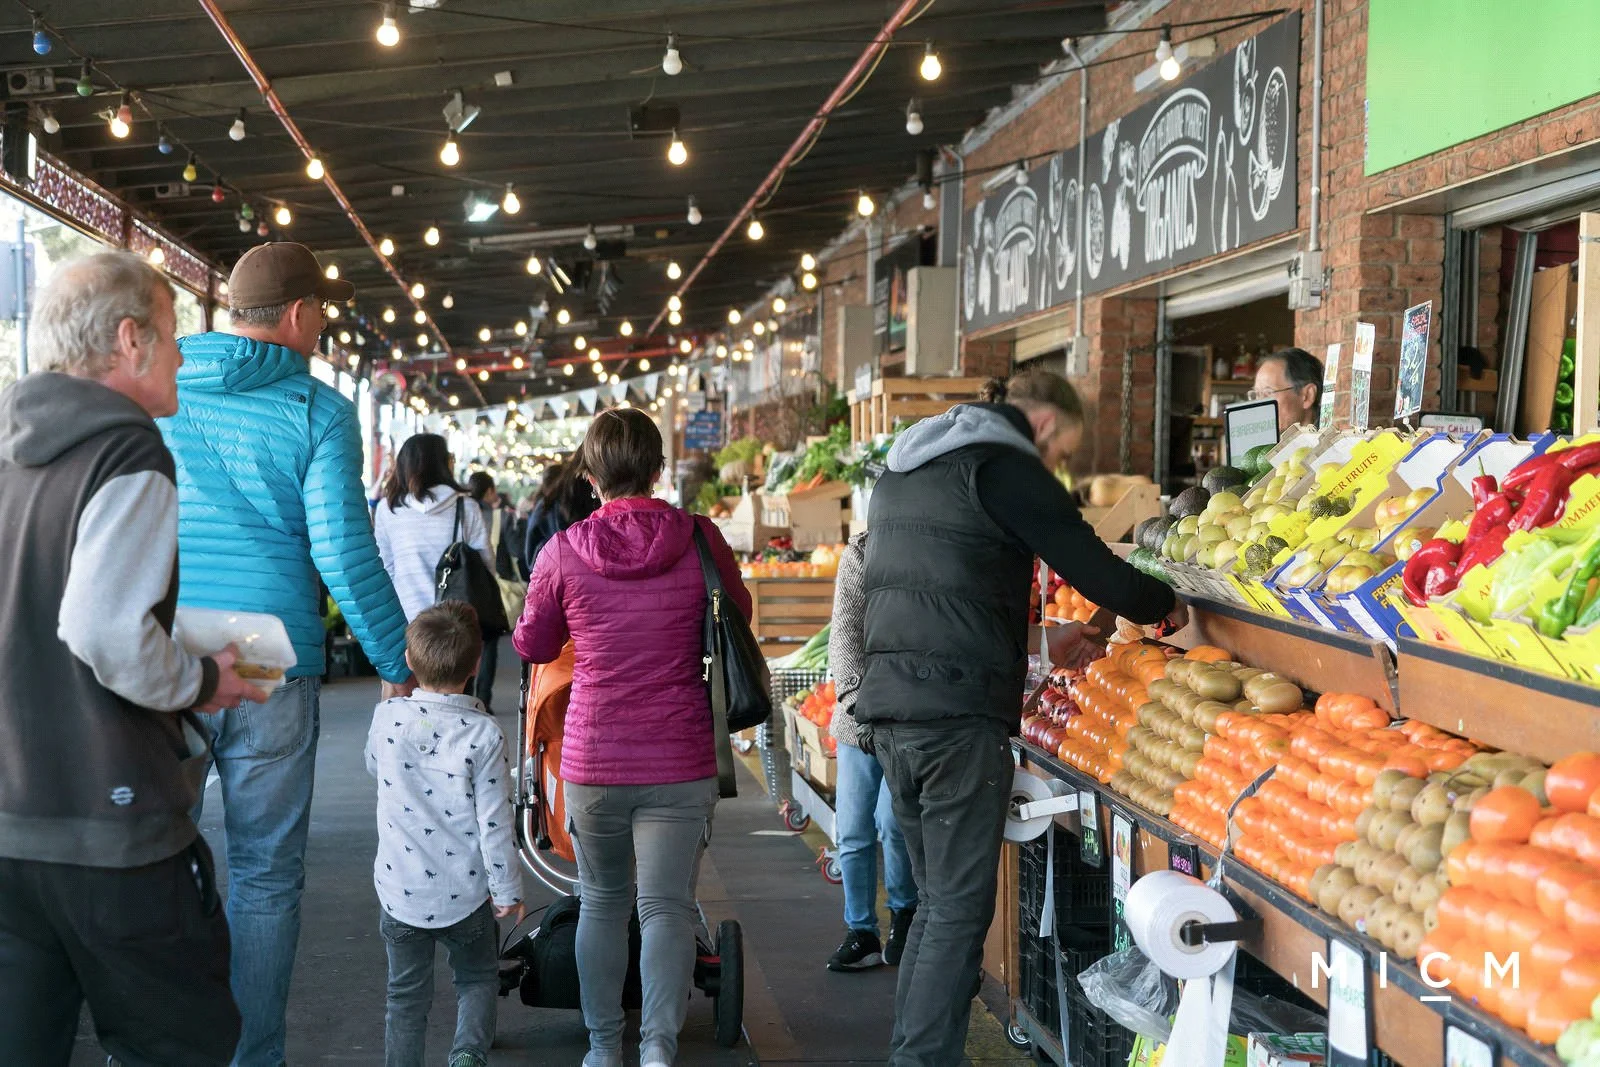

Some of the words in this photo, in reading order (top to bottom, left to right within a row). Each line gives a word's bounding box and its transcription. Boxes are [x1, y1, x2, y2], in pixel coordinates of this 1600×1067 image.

[1145, 160, 1198, 263] ORGANICS
[1345, 452, 1379, 484] FRUITS
[1371, 573, 1403, 601] FRESH
